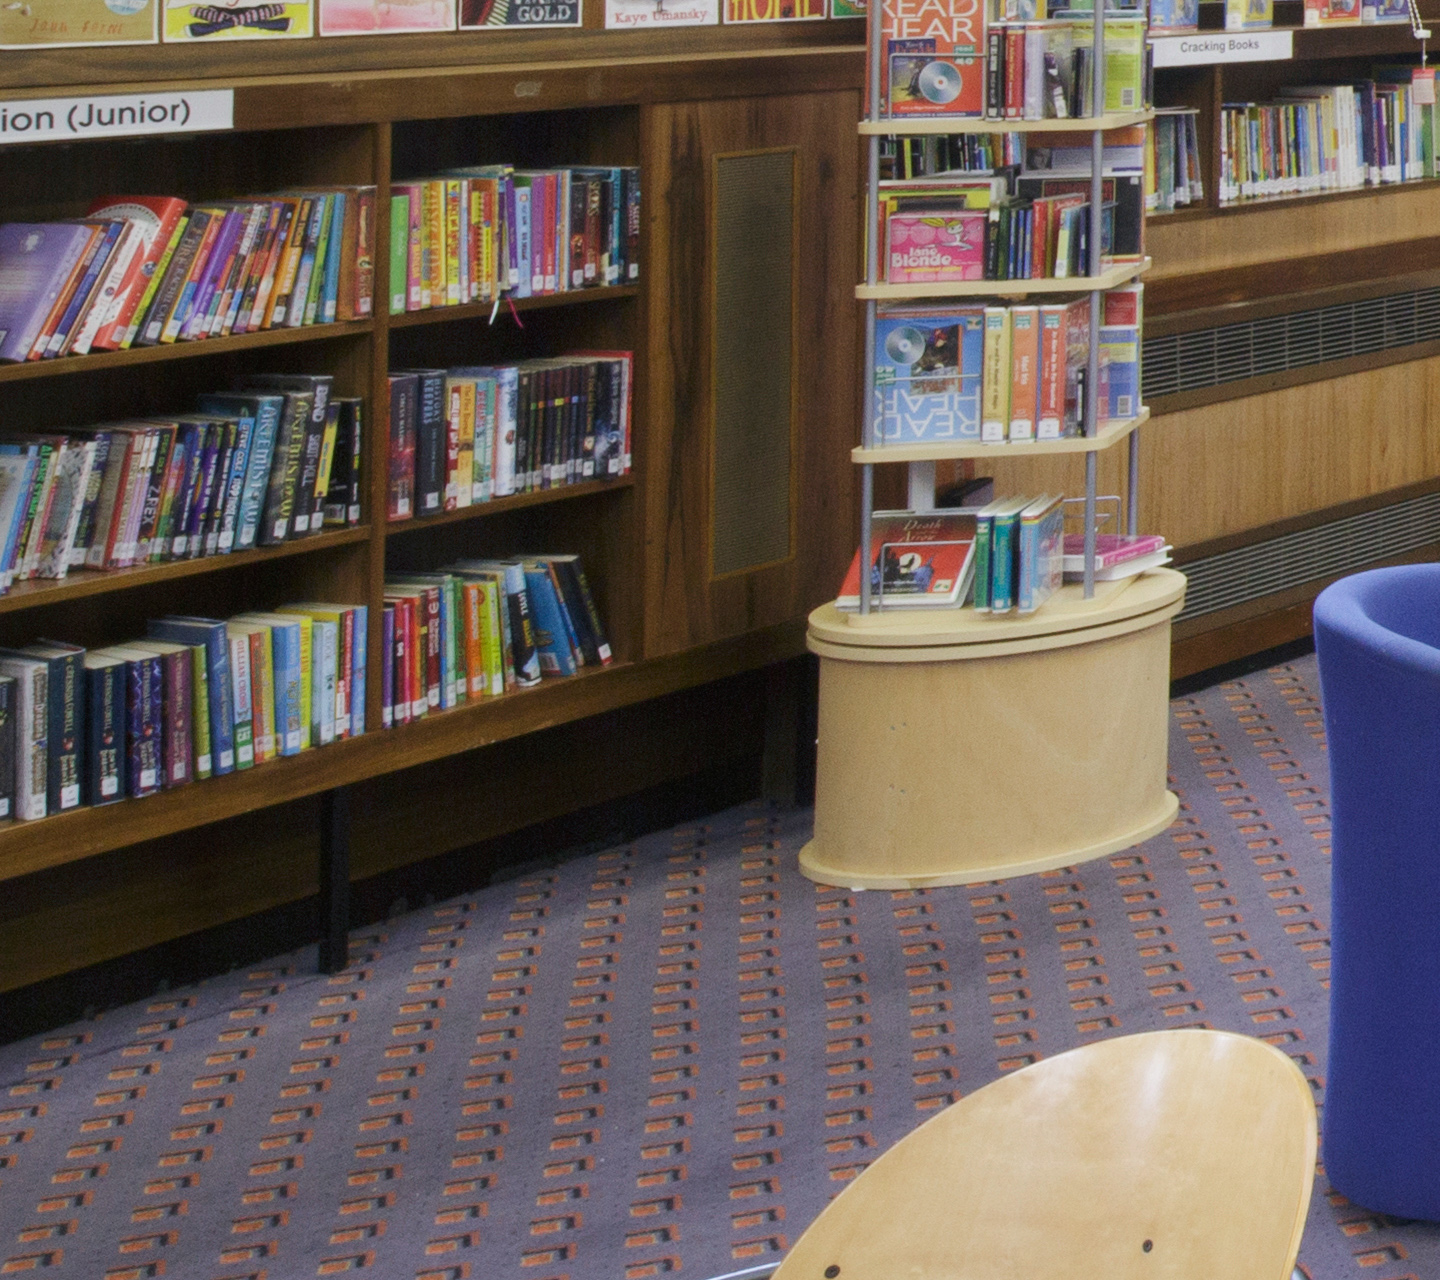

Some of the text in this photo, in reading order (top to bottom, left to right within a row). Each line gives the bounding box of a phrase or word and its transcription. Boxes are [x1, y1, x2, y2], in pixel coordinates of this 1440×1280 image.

[517, 4, 572, 23] GOLD
[614, 8, 708, 25] Kaye Umansky
[1180, 39, 1260, 53] Cracking Books
[67, 97, 191, 133] (Junior)
[164, 237, 195, 303] FIRE RACHEL
[890, 251, 952, 268] Blonde
[313, 384, 329, 423] BOND
[422, 379, 434, 425] KEEPERS
[433, 378, 442, 424] HISTORY
[234, 423, 250, 471] STEVE COLE
[252, 405, 278, 480] ARTEMIS
[287, 401, 311, 474] ARTEMIS
[301, 433, 321, 488] SHOOT KILL
[141, 484, 161, 526] Z.REX
[236, 639, 249, 709] GILLIAN CROSS
